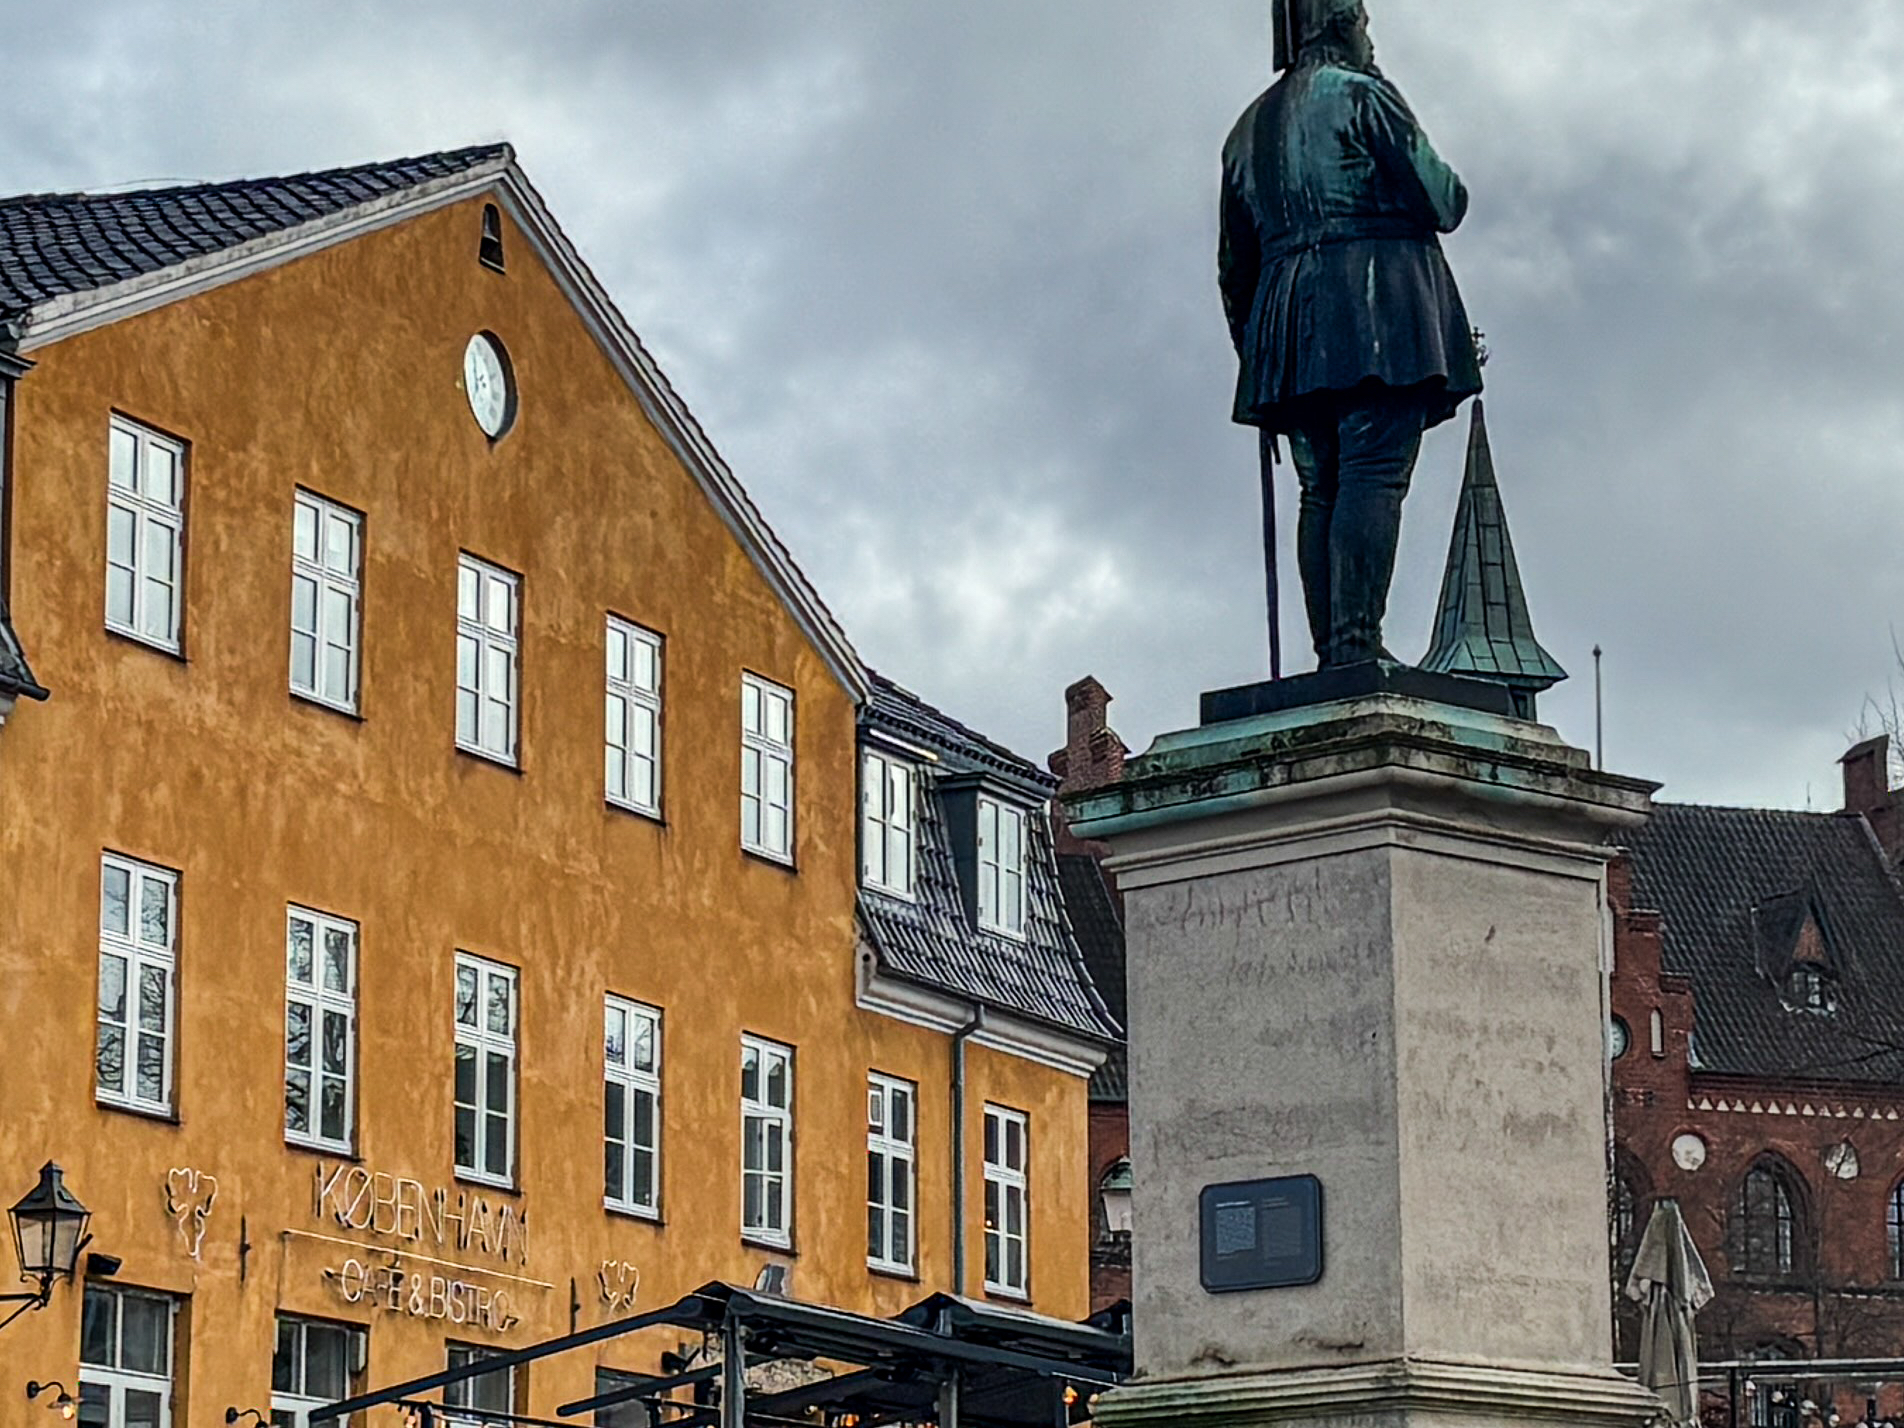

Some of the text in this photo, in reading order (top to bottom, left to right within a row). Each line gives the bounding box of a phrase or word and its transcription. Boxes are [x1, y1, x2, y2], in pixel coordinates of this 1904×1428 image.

[317, 1161, 529, 1265] KØBENHAVN
[409, 1273, 425, 1315] &
[430, 1276, 512, 1332] BISTRO
